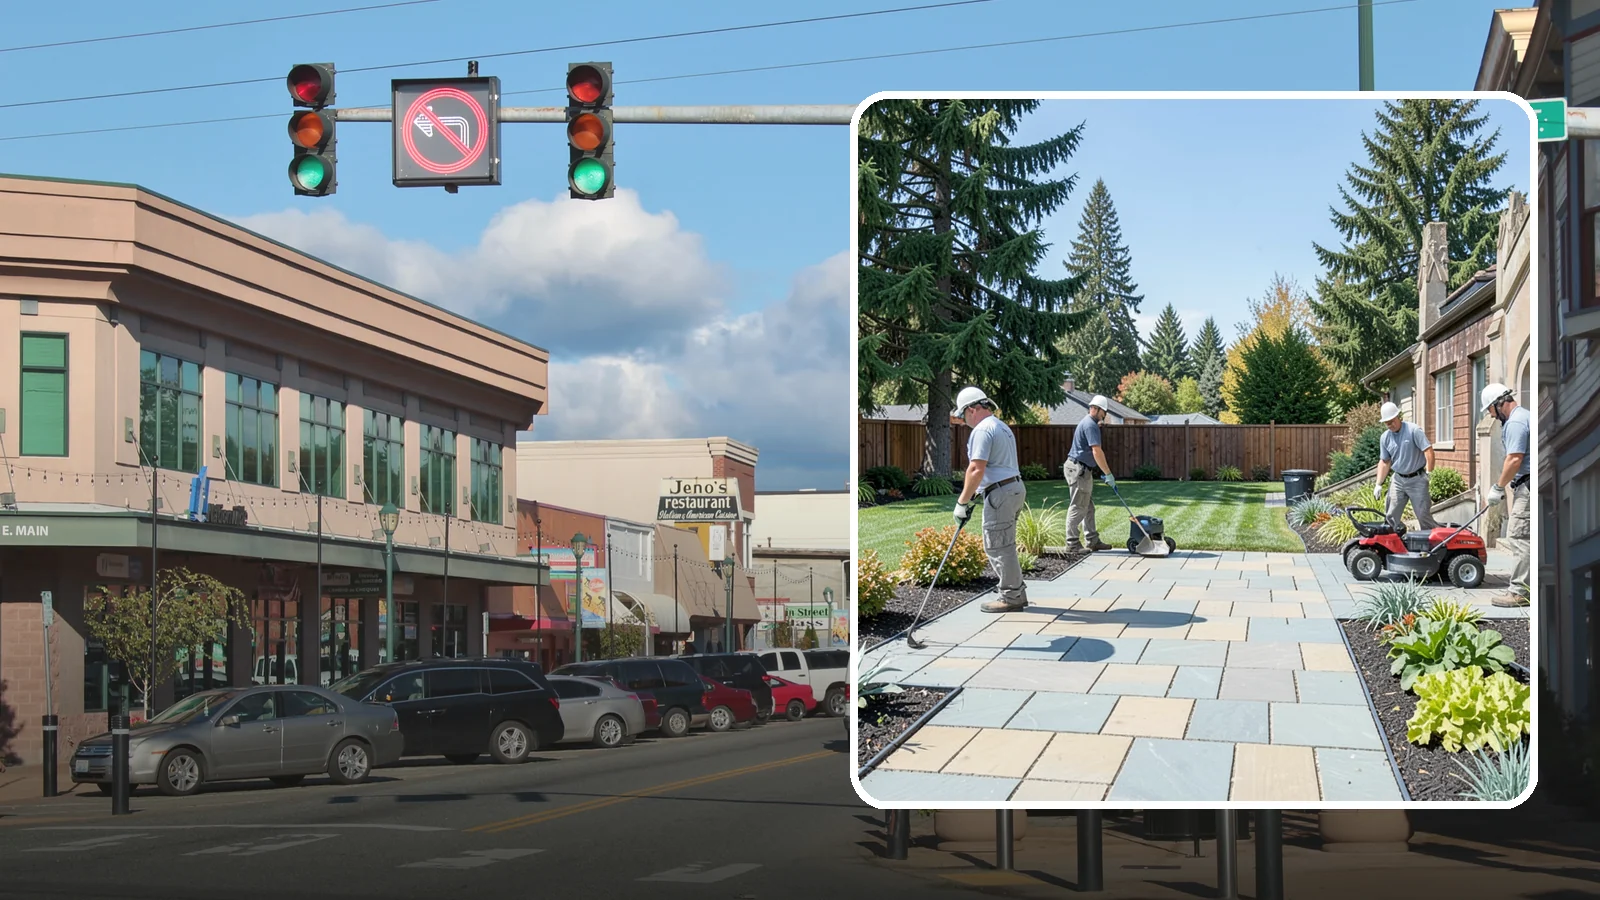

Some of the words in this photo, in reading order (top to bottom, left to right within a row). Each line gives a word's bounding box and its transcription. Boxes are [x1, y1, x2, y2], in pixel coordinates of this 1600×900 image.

[670, 480, 727, 494] Jeno's
[665, 496, 731, 509] restaurant
[659, 510, 681, 519] Italian
[686, 510, 715, 519] American
[715, 509, 737, 519] Cuisine
[2, 525, 13, 536] E.
[15, 525, 49, 536] MAIN
[797, 607, 828, 617] Street
